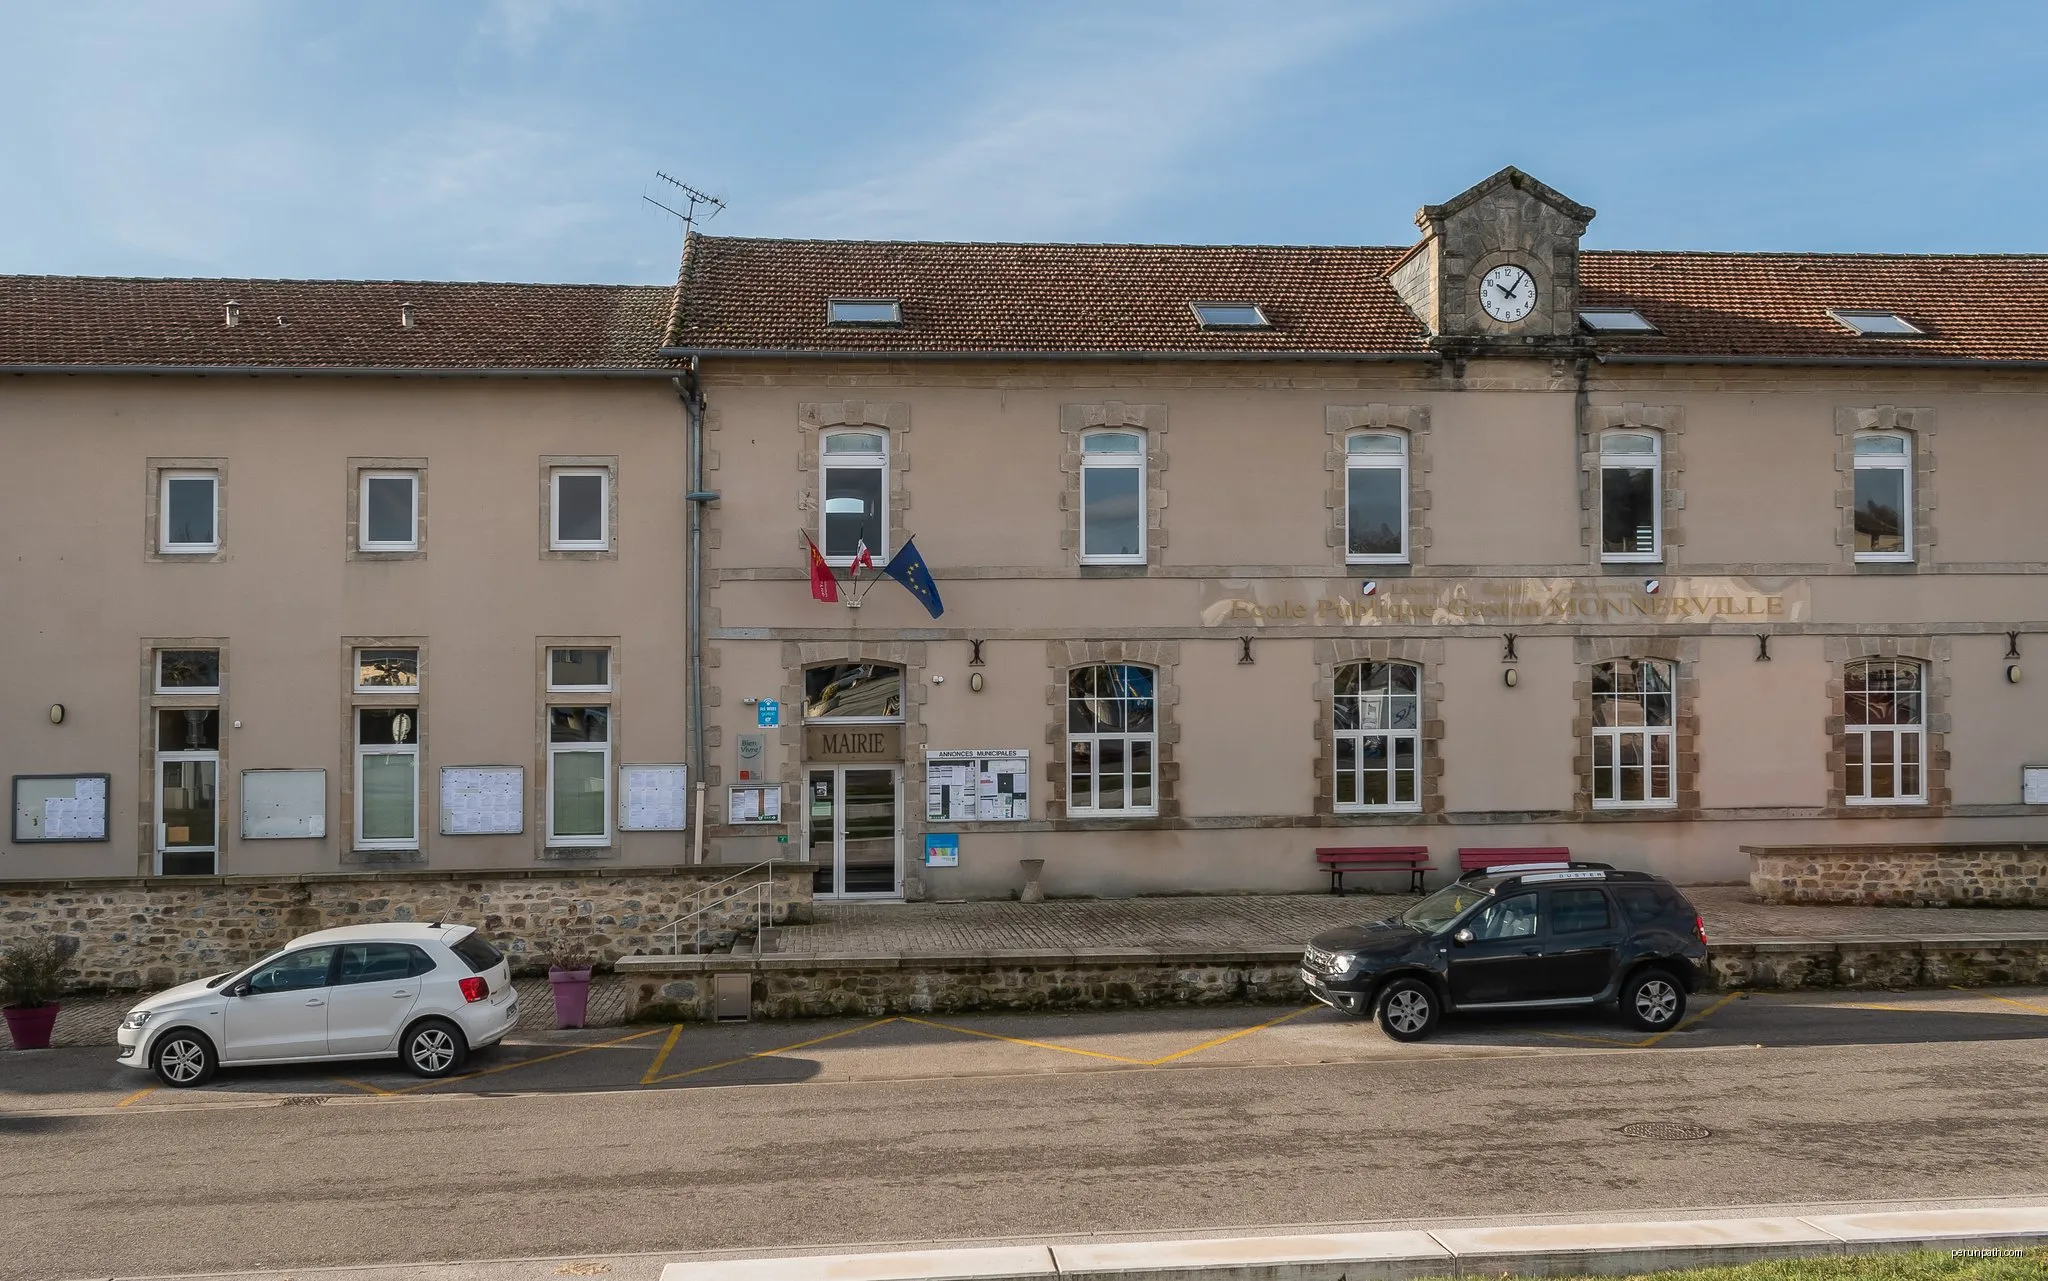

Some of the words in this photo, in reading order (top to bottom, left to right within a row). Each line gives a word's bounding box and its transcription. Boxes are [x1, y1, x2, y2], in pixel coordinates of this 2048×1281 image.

[1231, 599, 1306, 619] Ecole
[1317, 599, 1436, 622] Publique
[1547, 596, 1784, 617] MONNERVILLE
[821, 733, 885, 754] MAIRIE
